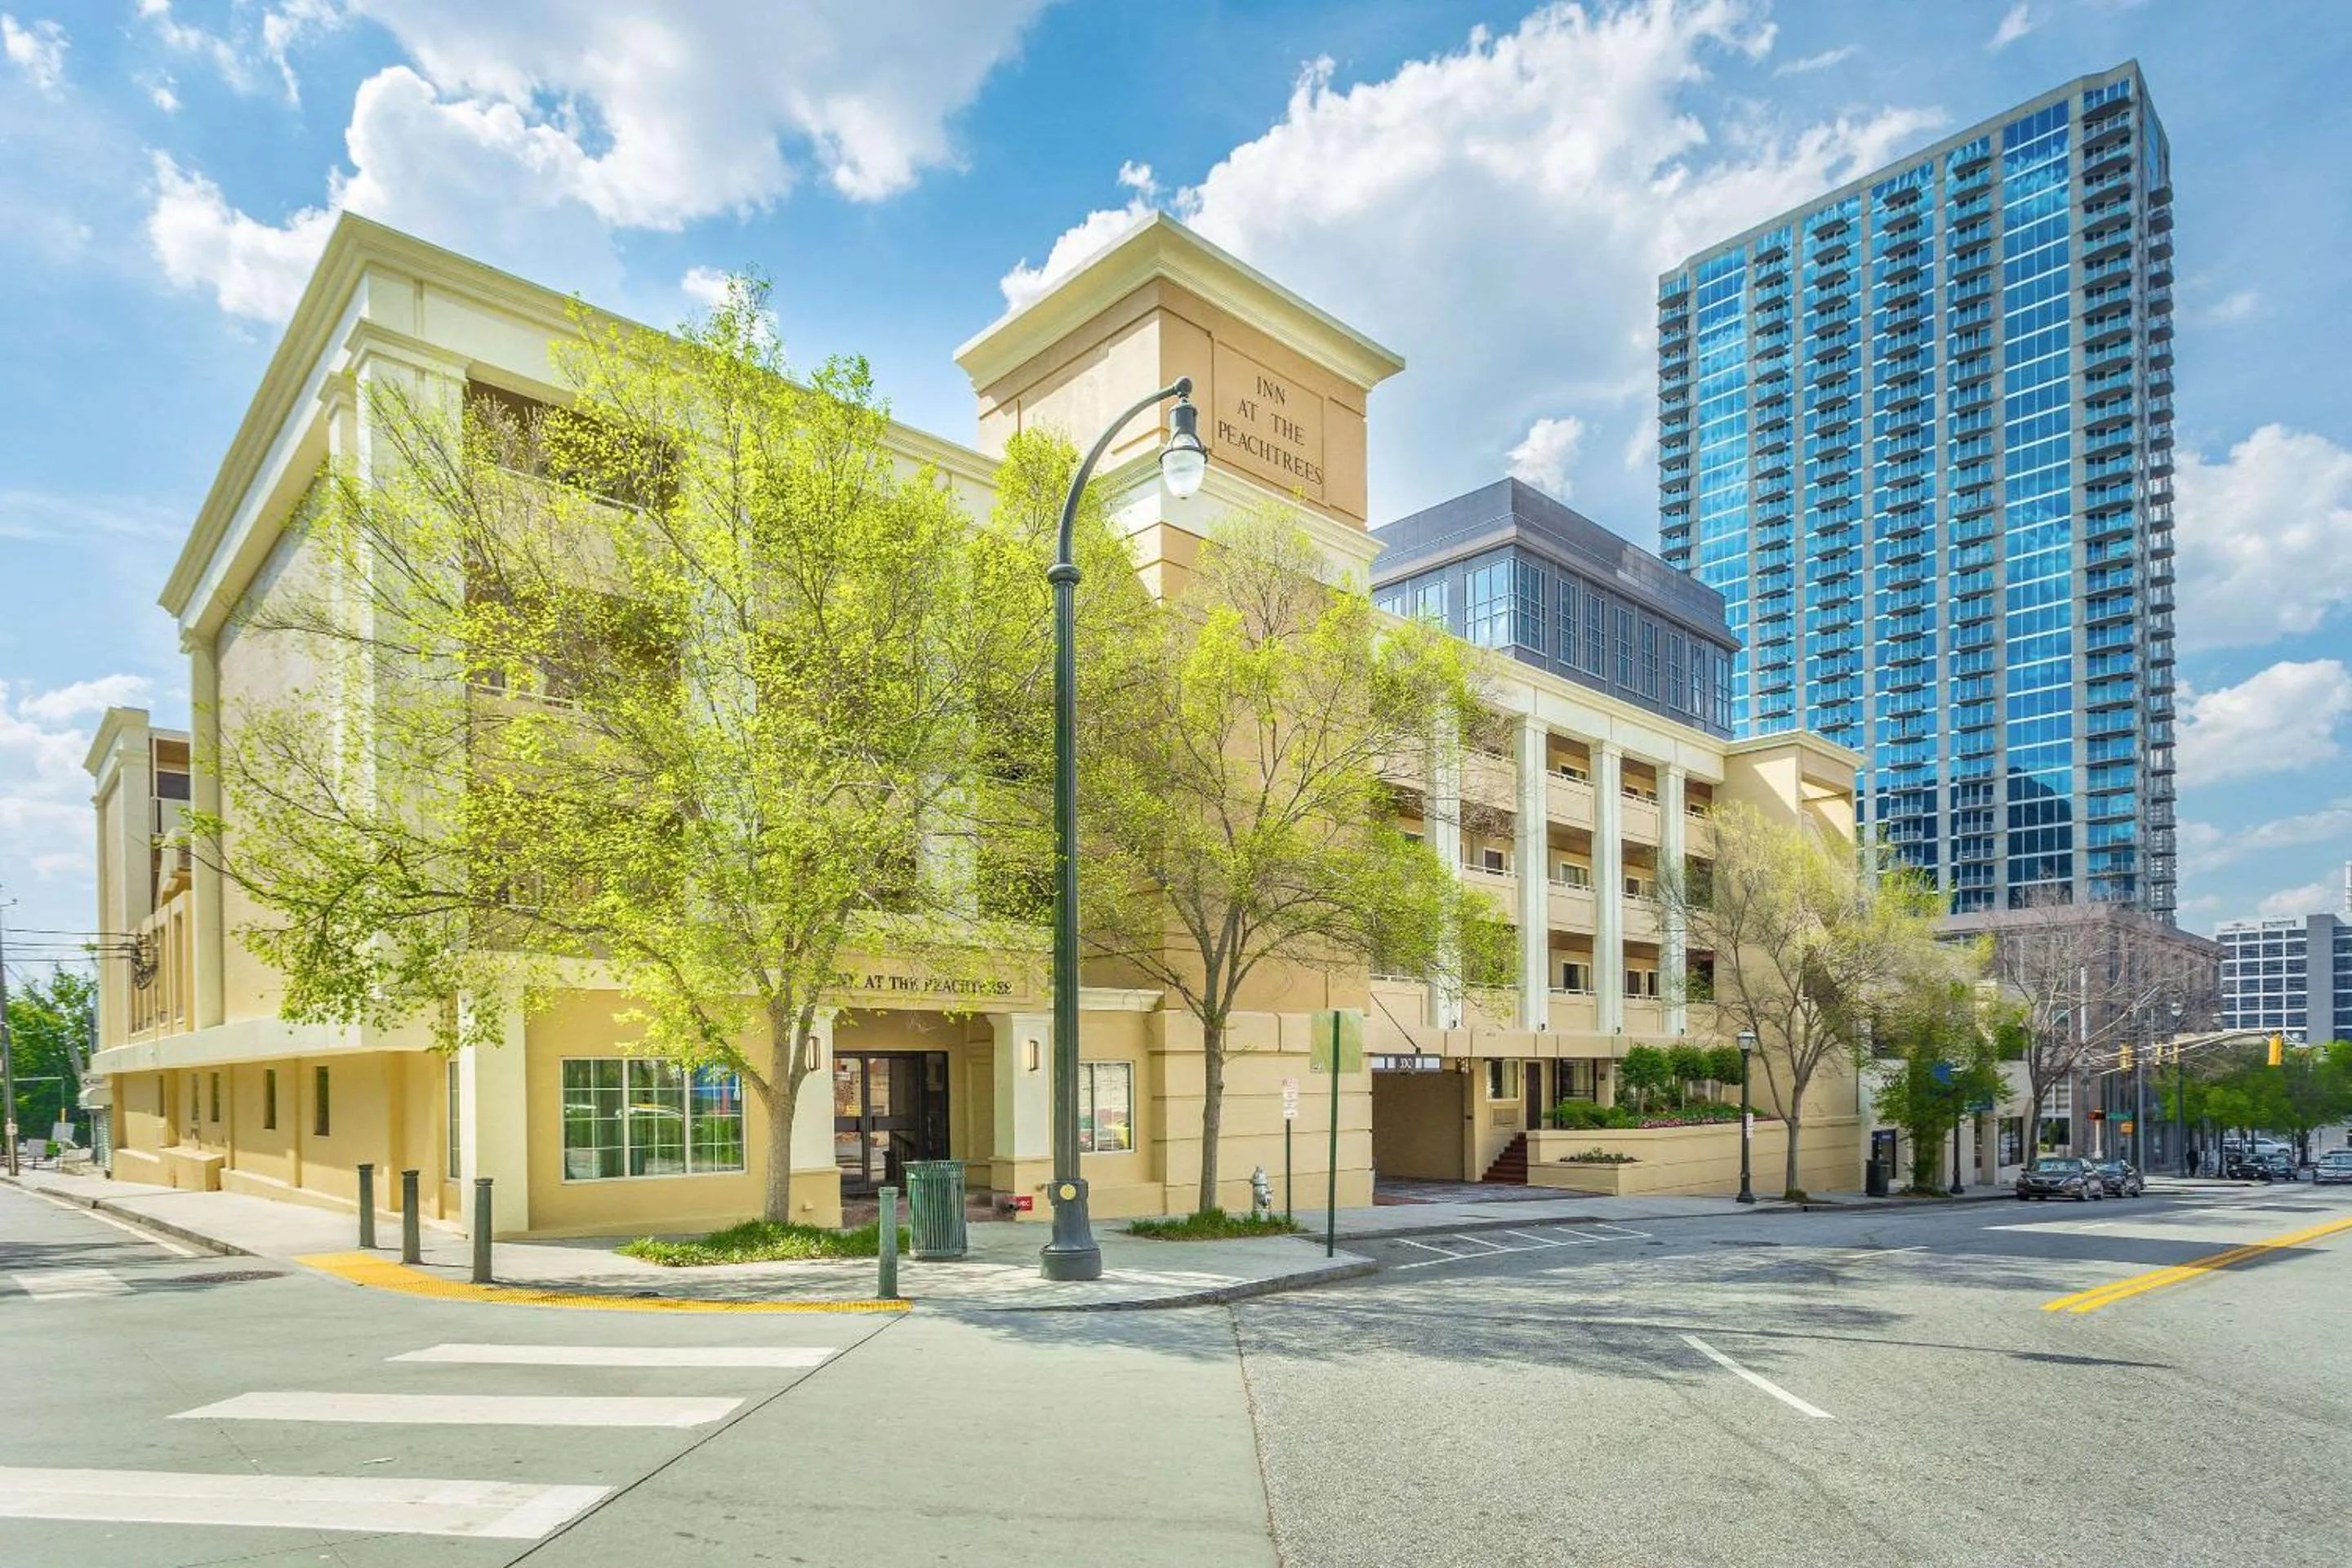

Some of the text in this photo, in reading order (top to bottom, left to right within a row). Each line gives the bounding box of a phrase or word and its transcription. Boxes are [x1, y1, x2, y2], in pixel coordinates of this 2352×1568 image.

[1256, 376, 1285, 406] INN
[1237, 399, 1304, 445] AT THE
[1218, 420, 1323, 485] PEACHTREES
[864, 974, 884, 988] AT
